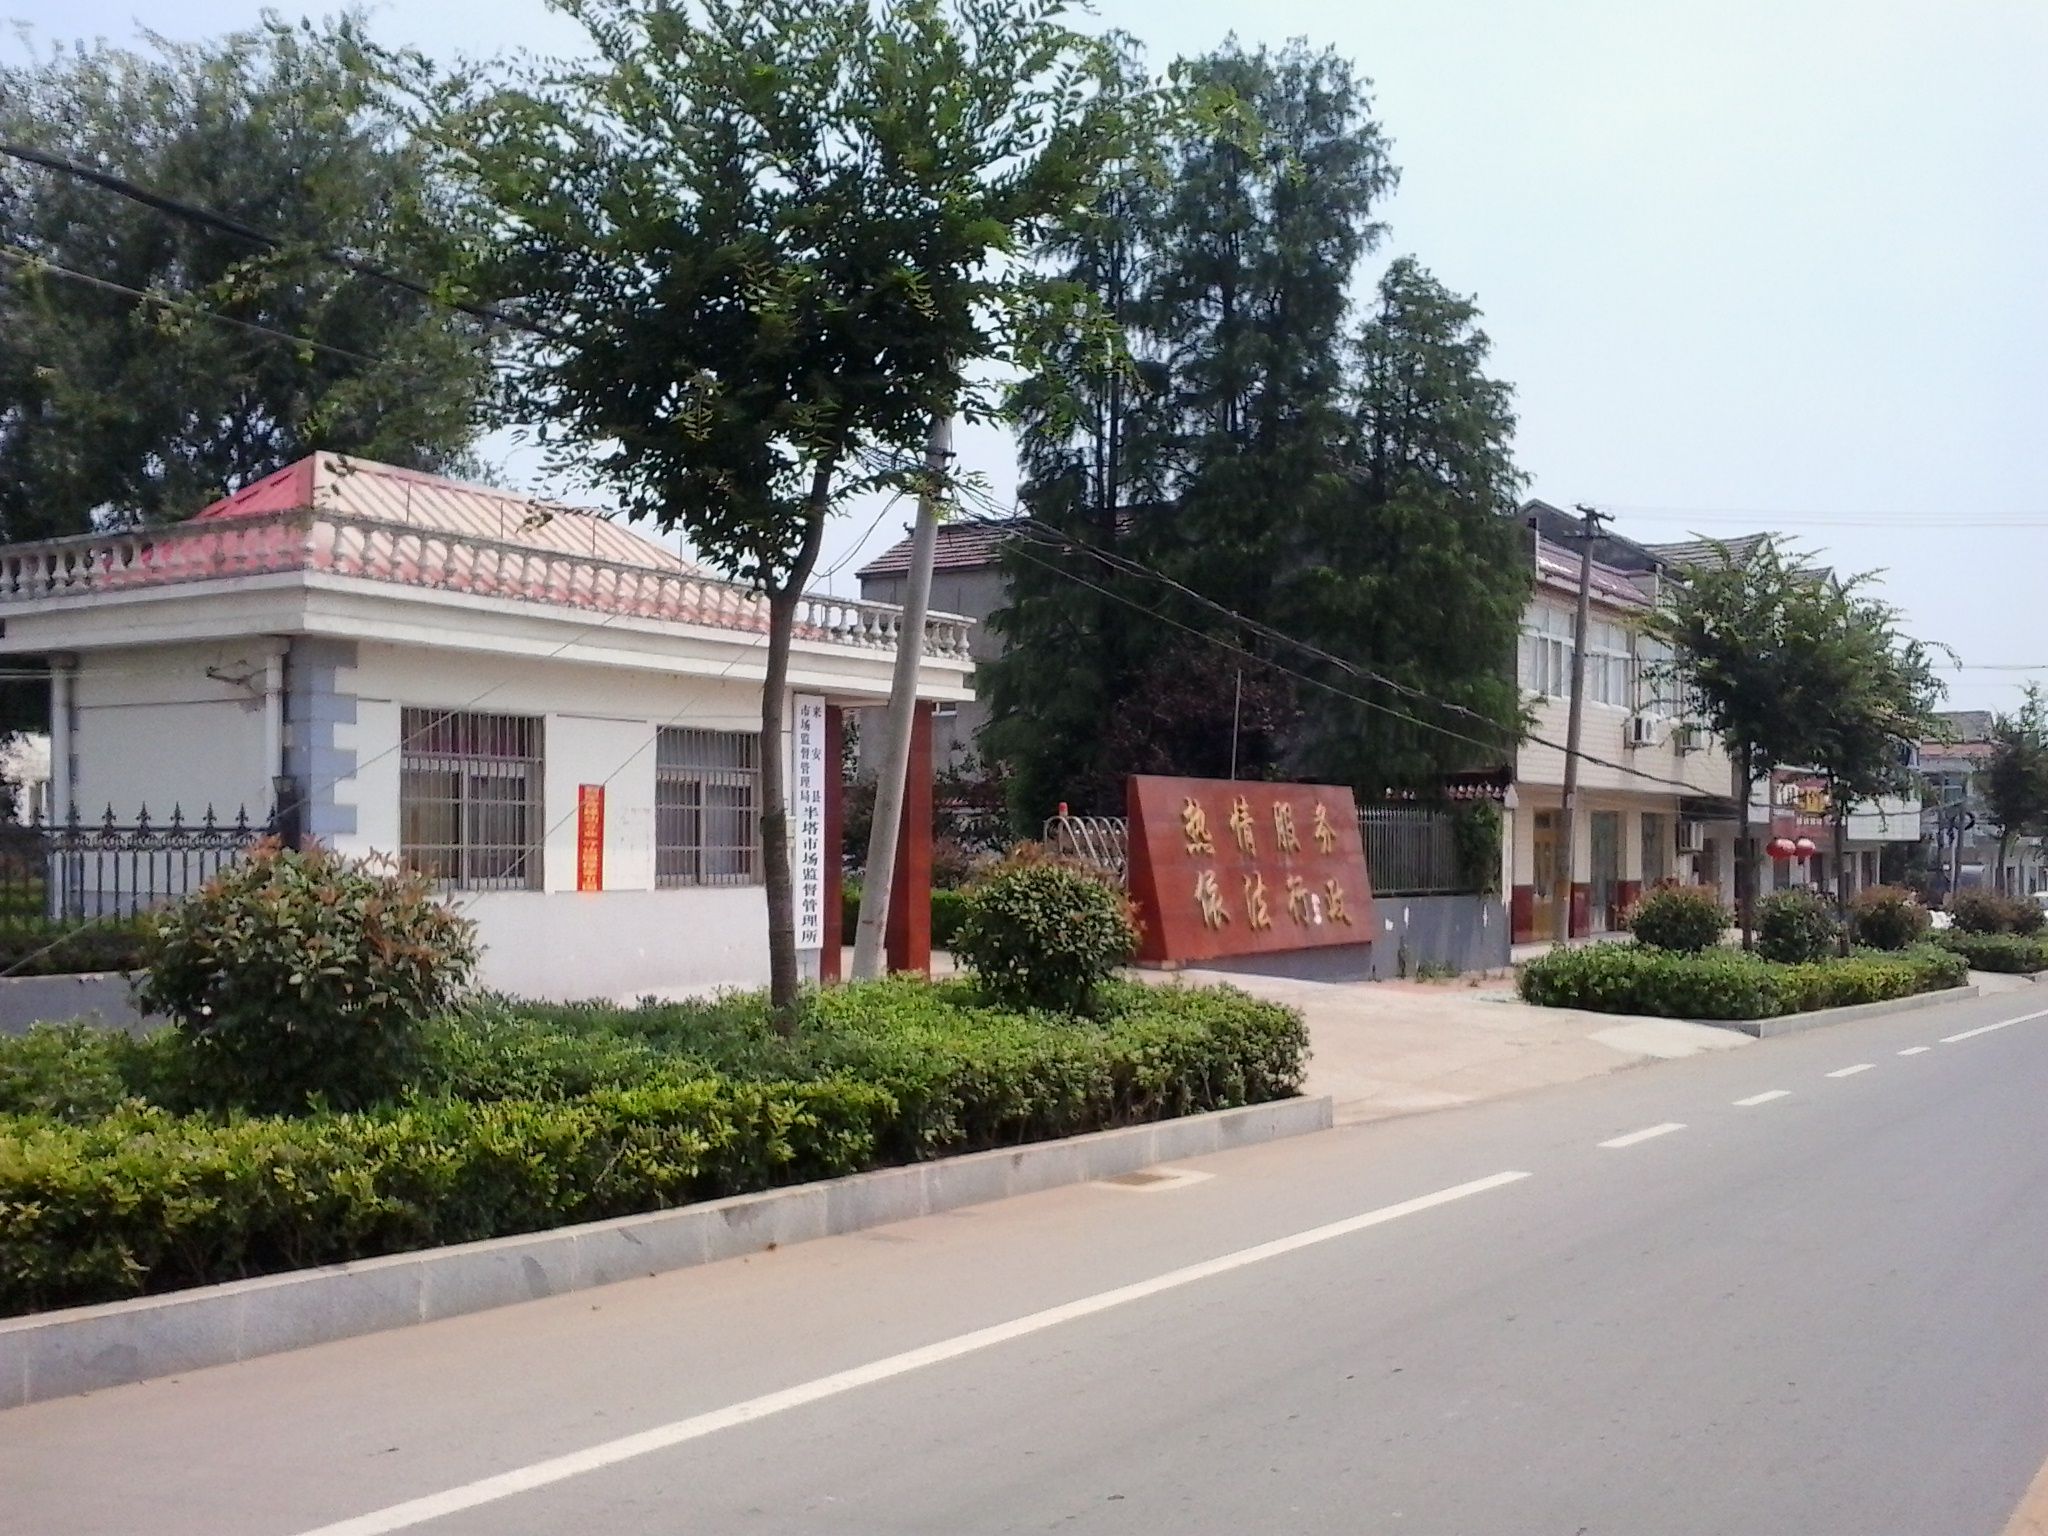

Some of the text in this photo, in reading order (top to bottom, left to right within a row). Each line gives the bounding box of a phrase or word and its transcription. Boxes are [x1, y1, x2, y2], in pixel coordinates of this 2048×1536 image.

[800, 704, 811, 804] 市场监督管理局
[801, 805, 819, 943] 半塔市场监督管理所
